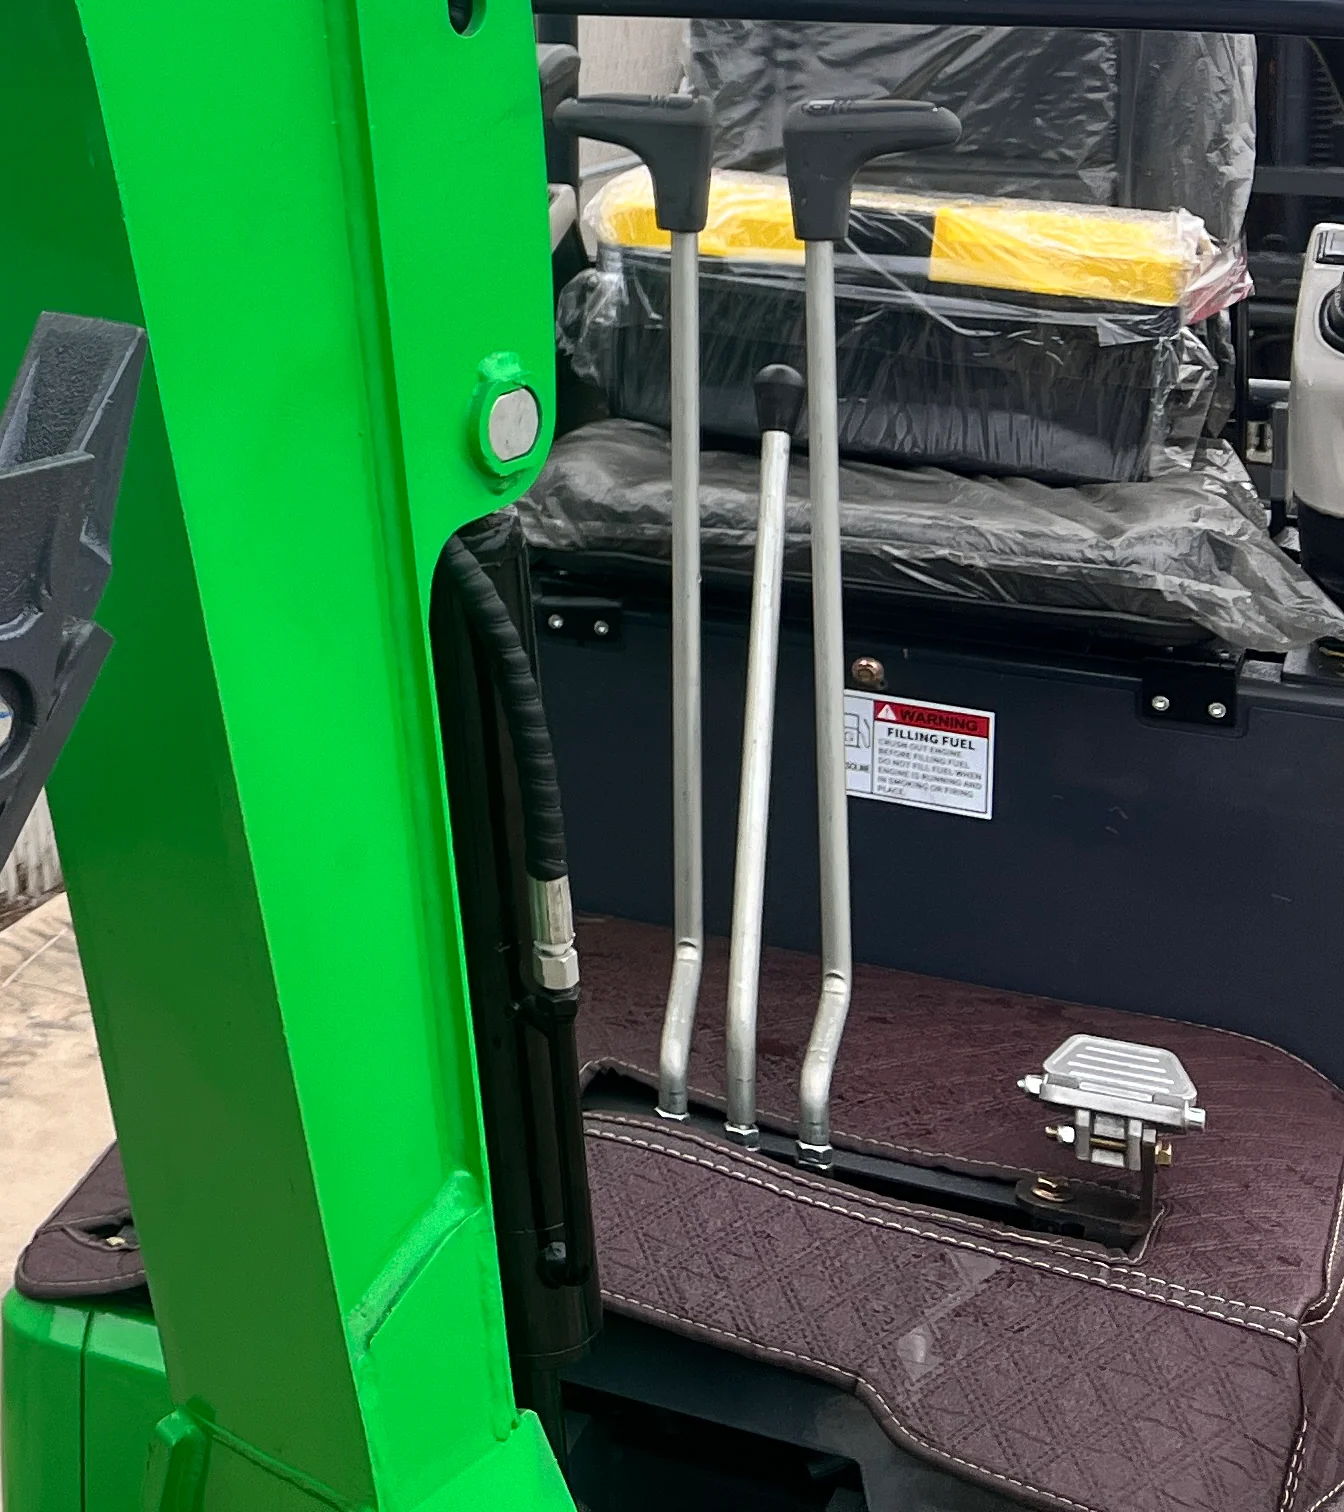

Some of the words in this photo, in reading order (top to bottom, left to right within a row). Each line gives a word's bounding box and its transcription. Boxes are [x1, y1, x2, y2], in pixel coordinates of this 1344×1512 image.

[900, 708, 979, 732] WARNING
[887, 727, 939, 744] FILLING
[942, 736, 976, 750] FUEL
[878, 747, 910, 758] BEFORE
[913, 752, 946, 765] FILLING
[892, 759, 910, 768] NOT
[955, 769, 982, 780] WHEN
